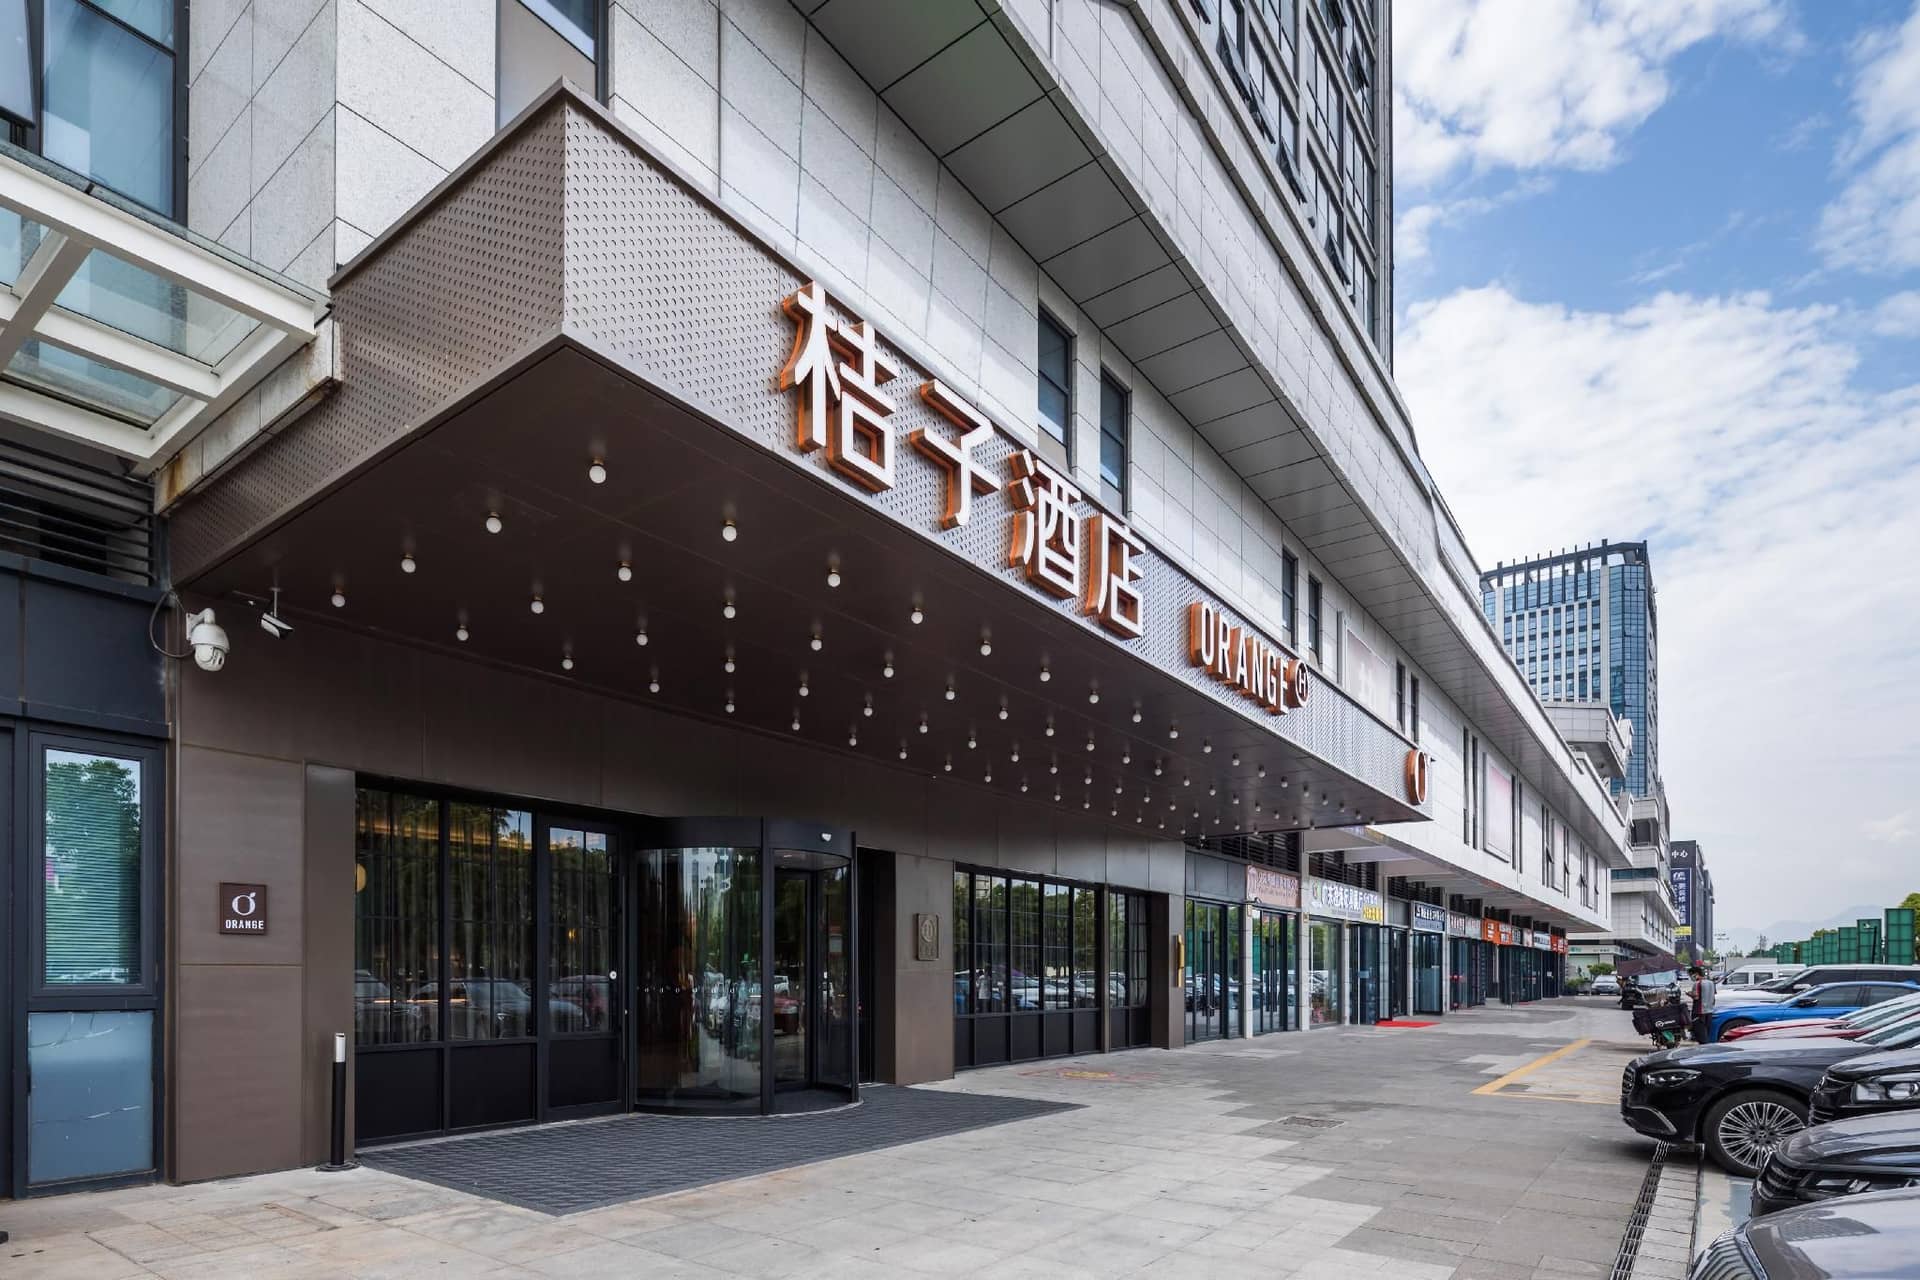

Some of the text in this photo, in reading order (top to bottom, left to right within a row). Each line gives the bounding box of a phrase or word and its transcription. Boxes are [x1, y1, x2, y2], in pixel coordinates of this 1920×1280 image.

[785, 281, 1147, 639] 桔子酒店
[1197, 600, 1290, 715] ORANGE
[225, 919, 264, 930] ORANGE
